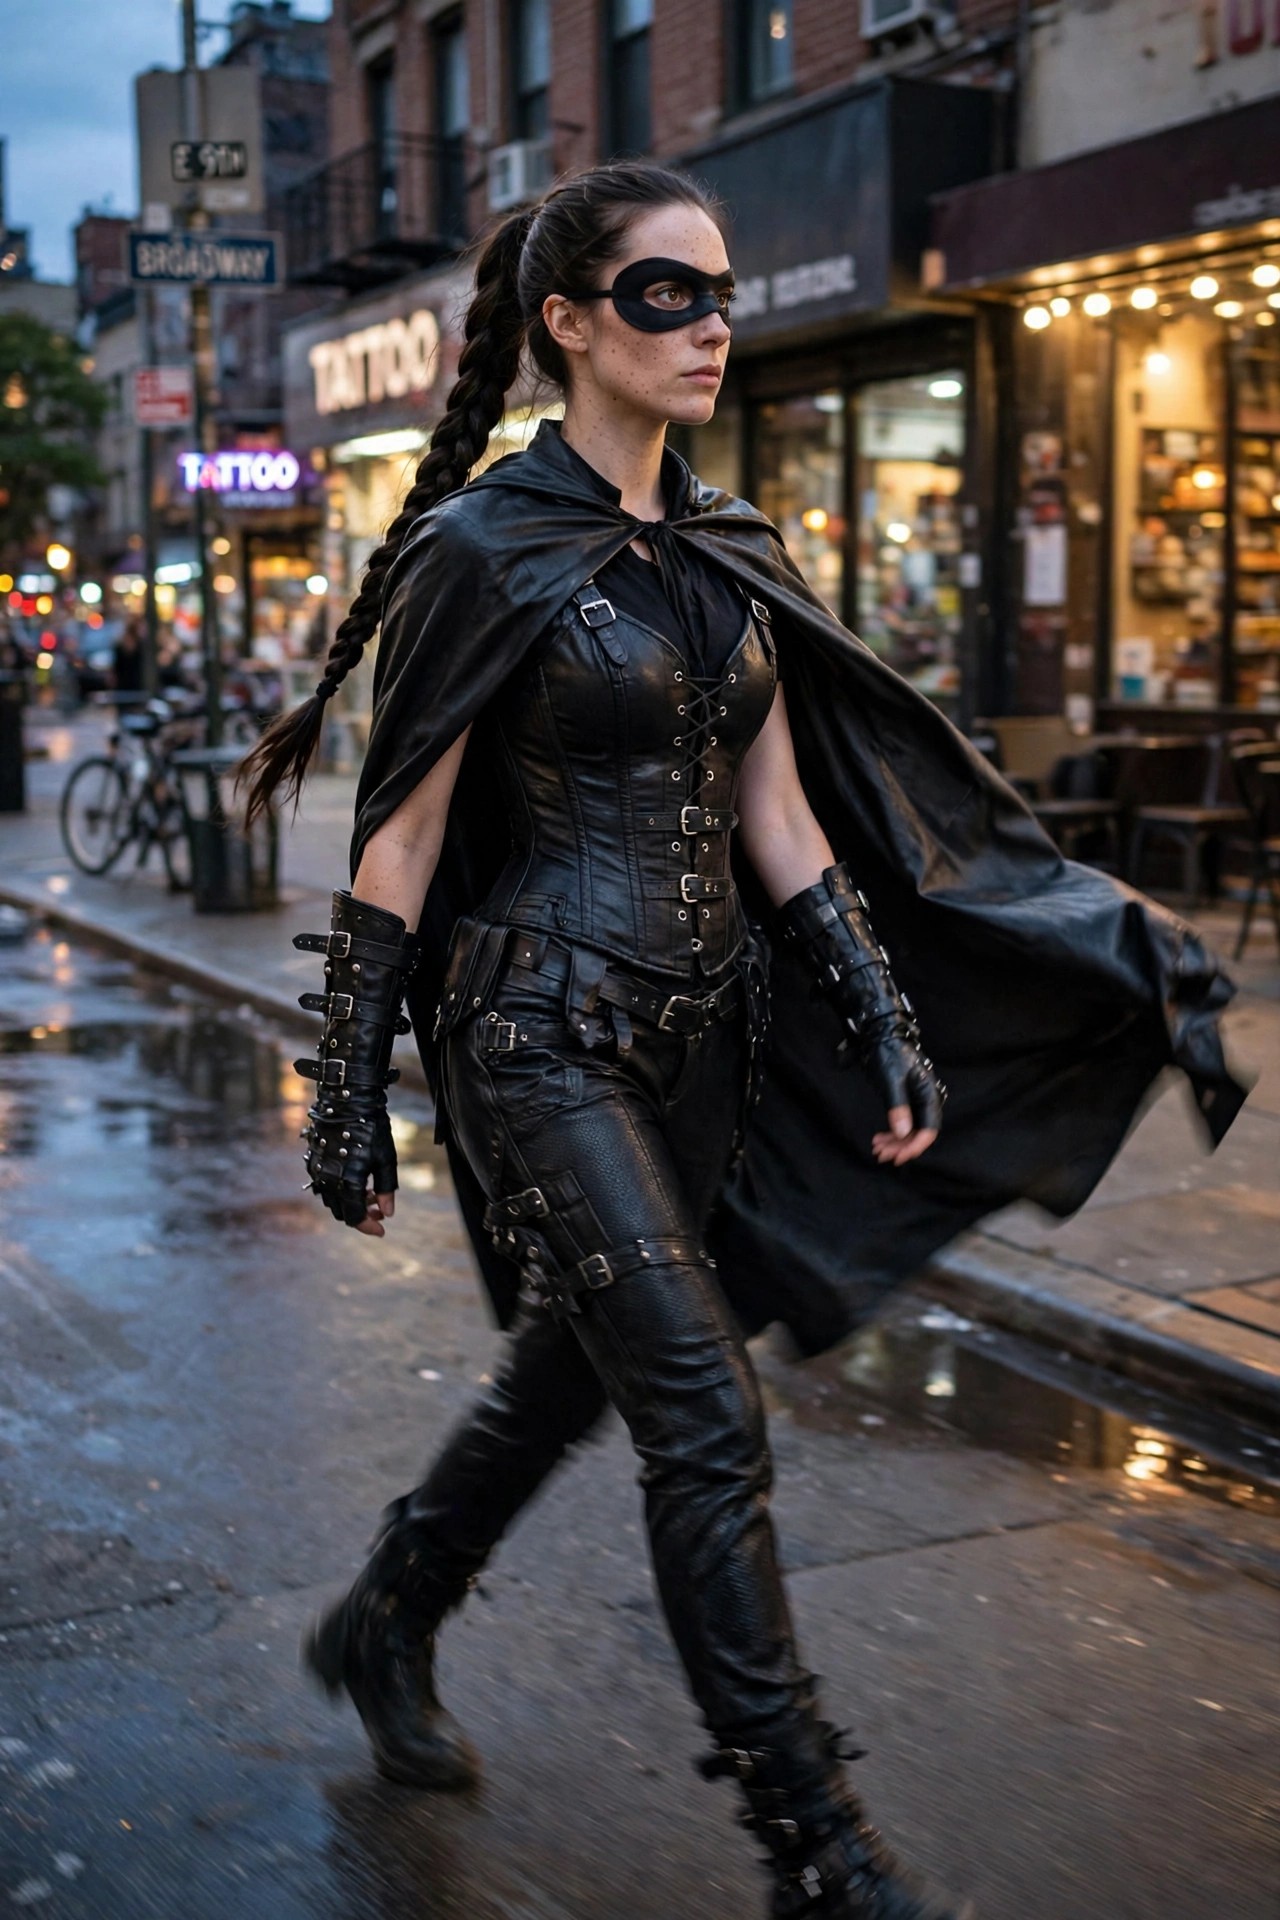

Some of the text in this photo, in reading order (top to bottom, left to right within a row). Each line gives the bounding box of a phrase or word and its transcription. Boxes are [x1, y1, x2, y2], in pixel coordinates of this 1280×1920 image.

[174, 144, 192, 177] E
[137, 241, 269, 279] BROADWAY
[309, 309, 439, 416] TATTOO
[177, 451, 300, 493] TATTOO
